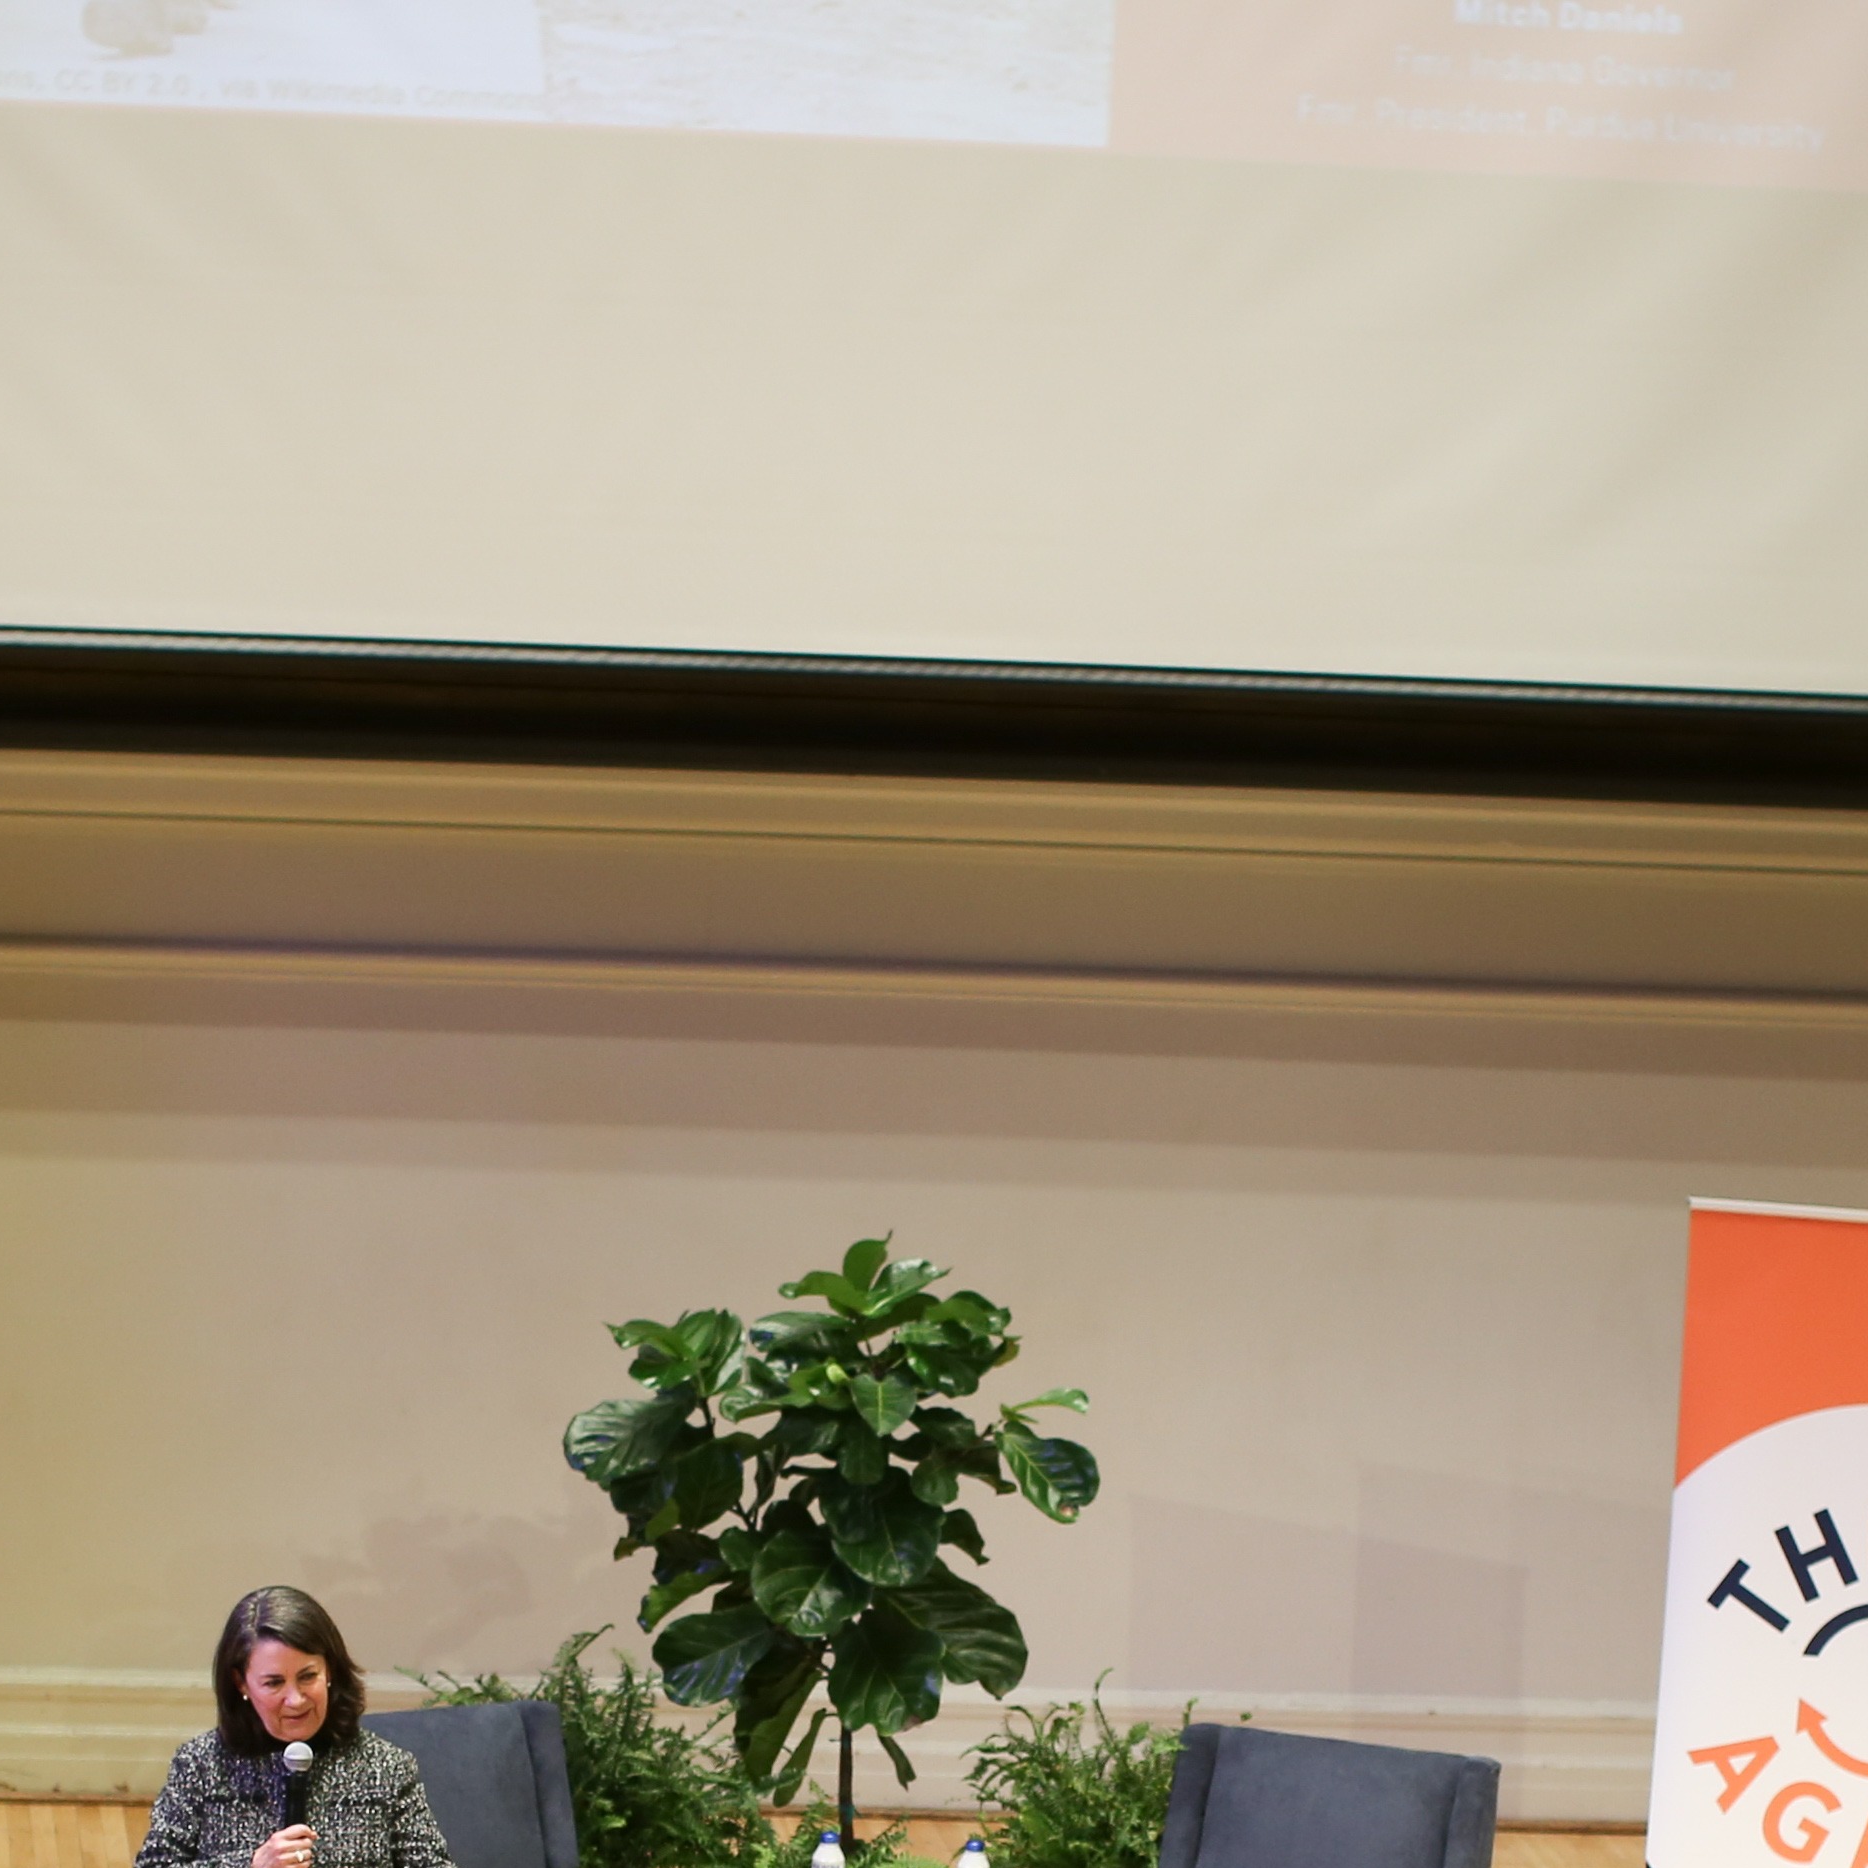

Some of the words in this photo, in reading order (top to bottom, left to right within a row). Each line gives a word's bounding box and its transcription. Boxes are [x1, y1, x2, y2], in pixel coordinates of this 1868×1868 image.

[1454, 0, 1549, 28] Mitch
[1558, 1, 1684, 35] Daniels
[54, 68, 92, 93] CC
[101, 70, 135, 94] BY
[217, 78, 259, 100] via
[266, 78, 404, 105] Wikimedia
[1470, 50, 1584, 86] Indiana
[1590, 55, 1734, 91] Governor
[1545, 104, 1656, 142] Purdue
[1663, 112, 1824, 152] University
